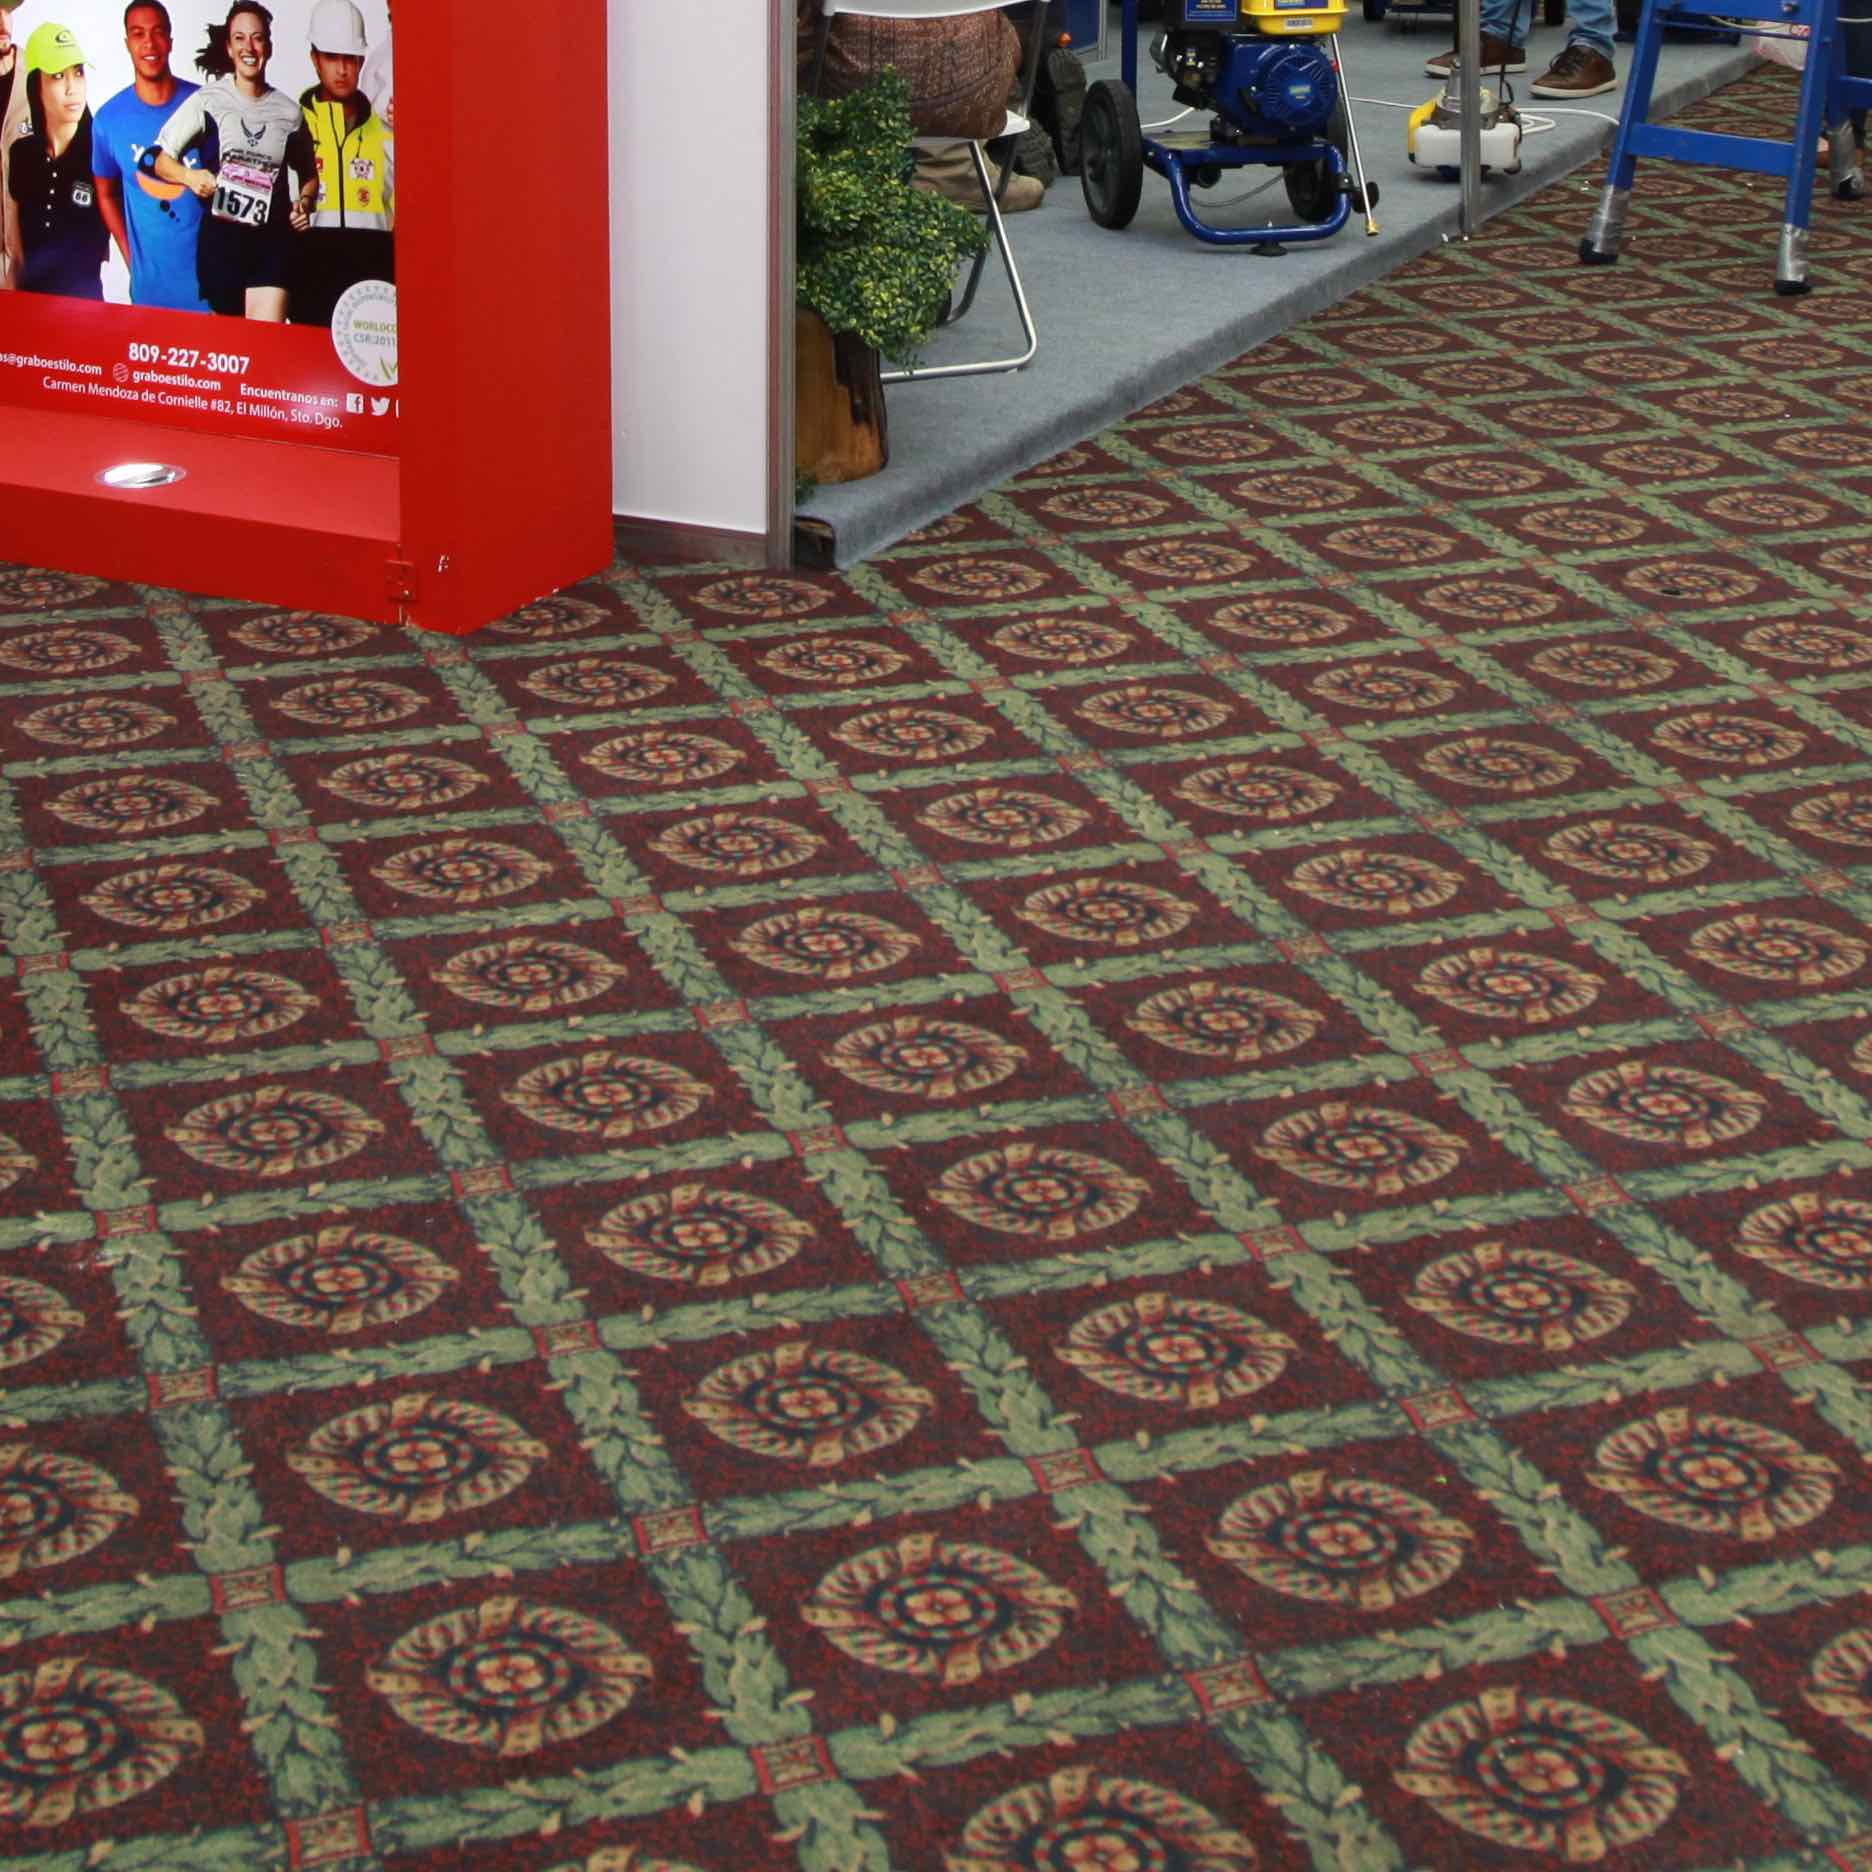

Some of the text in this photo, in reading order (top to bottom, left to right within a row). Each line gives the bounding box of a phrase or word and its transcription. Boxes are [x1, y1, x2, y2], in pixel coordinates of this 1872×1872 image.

[218, 187, 267, 225] 1573
[129, 342, 250, 375] 809-227-3007
[43, 376, 86, 393] Carmen
[89, 384, 139, 401] Mendoza
[141, 389, 156, 403] de
[159, 391, 207, 410] Cornielle
[237, 402, 248, 415] El
[291, 409, 314, 424] Sto.
[315, 413, 343, 430] Dgo.
[133, 369, 221, 391] graboestilo.com
[240, 384, 318, 406] Encuentranos
